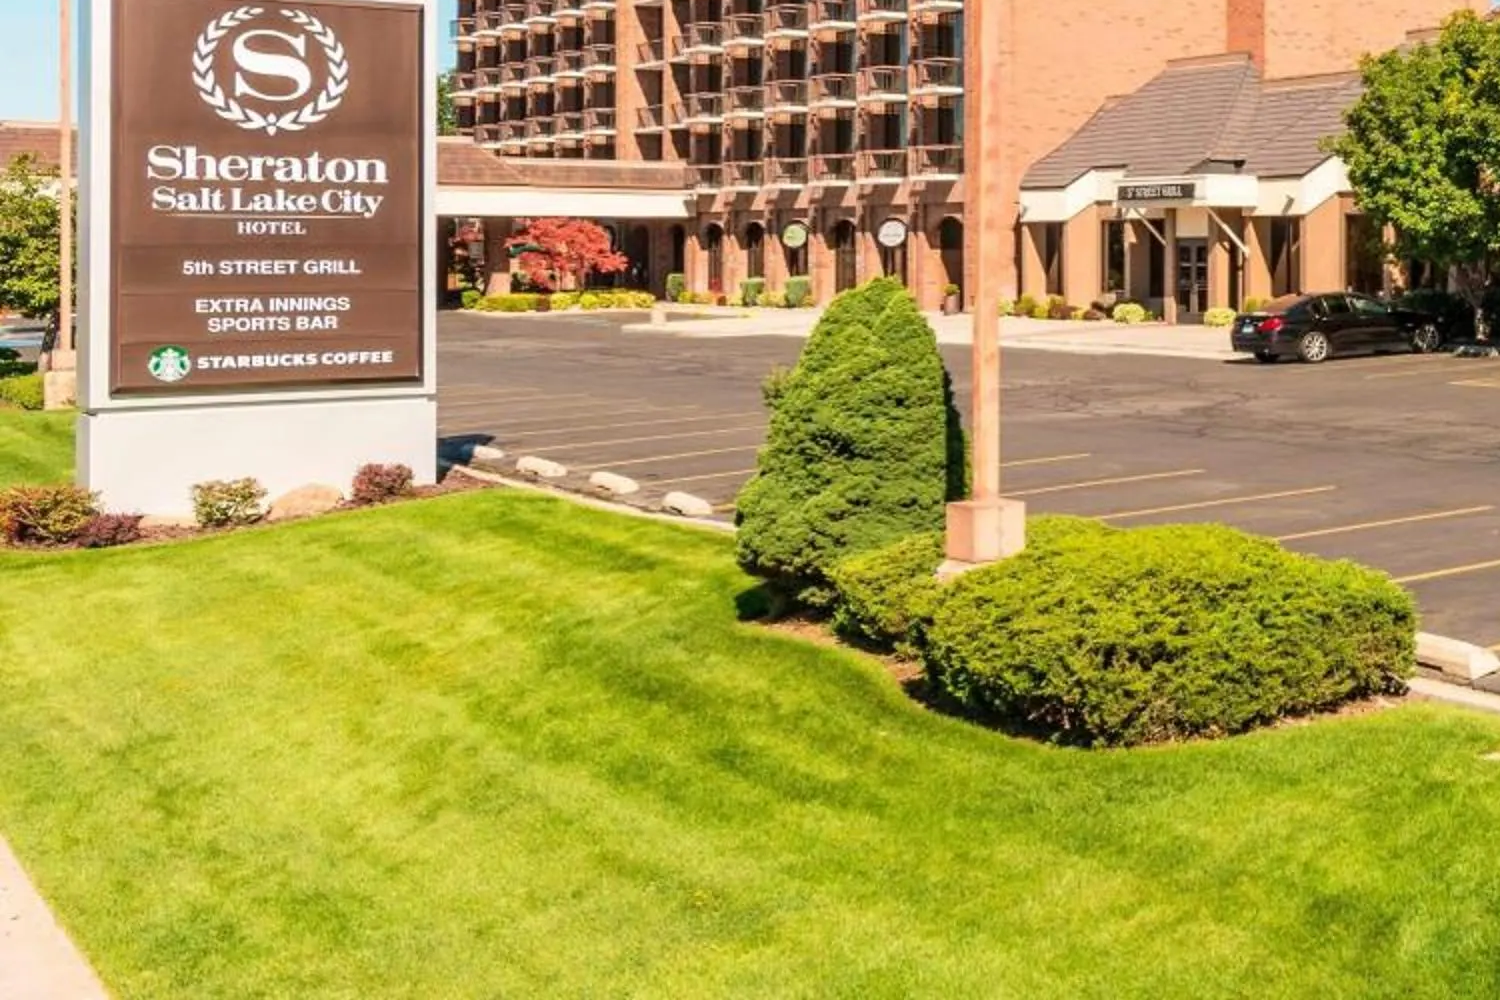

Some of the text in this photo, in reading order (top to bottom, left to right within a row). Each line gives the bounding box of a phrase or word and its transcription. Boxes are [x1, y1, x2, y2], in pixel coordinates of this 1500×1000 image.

[232, 28, 312, 102] S
[147, 144, 389, 184] Sheraton
[152, 186, 384, 219] Salt Lake City
[237, 220, 307, 235] HOTEL
[182, 259, 361, 275] 5th STREET GRILL
[195, 297, 350, 313] EXTRA INNINGS
[207, 315, 338, 333] SPORTS BAR
[197, 350, 393, 369] STARBUCKS COFFEE
